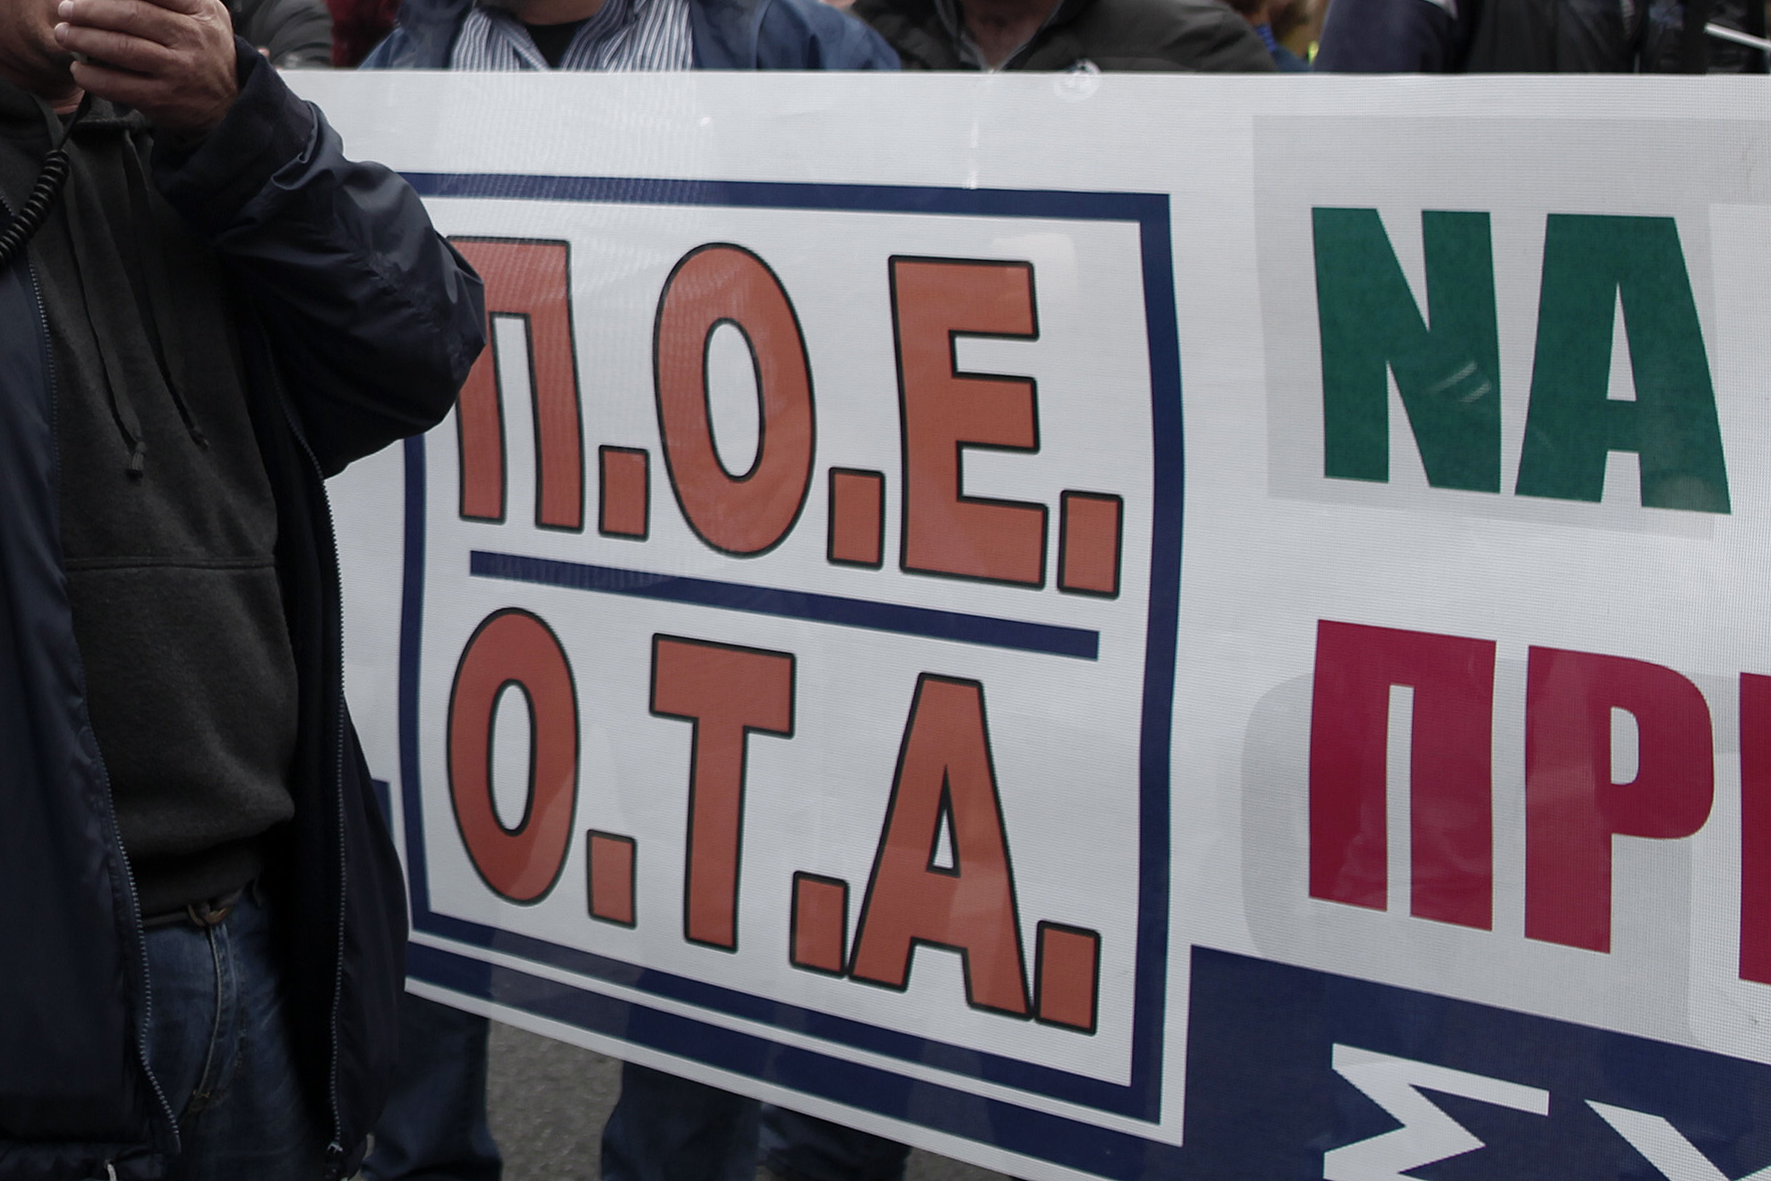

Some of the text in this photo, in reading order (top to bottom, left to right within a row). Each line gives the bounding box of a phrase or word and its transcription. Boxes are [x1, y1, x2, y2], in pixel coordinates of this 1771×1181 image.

[447, 234, 1125, 600] Π.Ο.Ε.
[1310, 206, 1732, 516] ΝΑ
[446, 606, 1102, 1036] Ο.Τ.Α.
